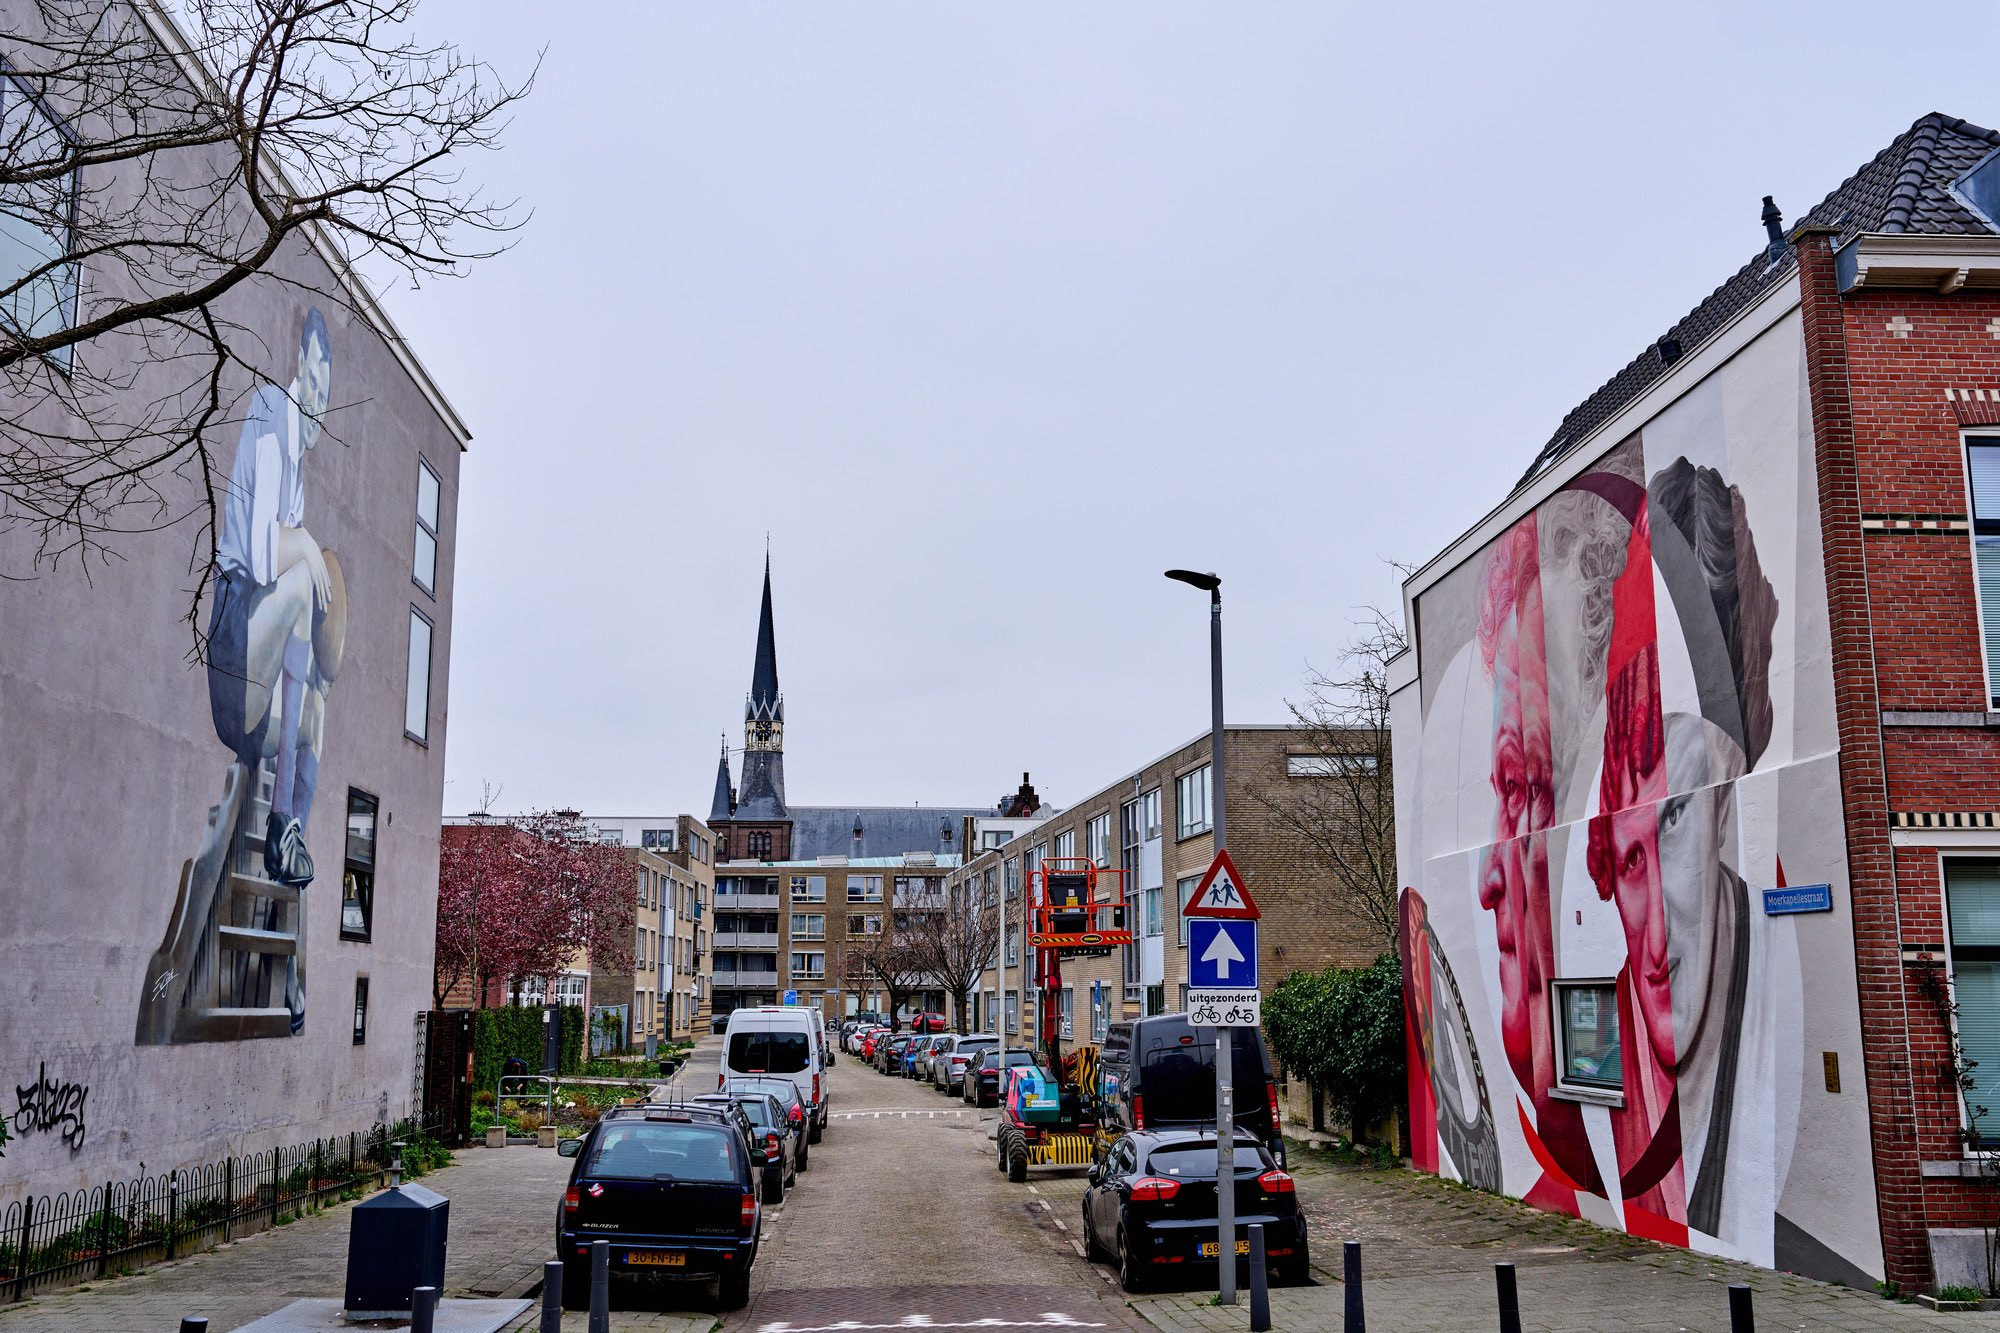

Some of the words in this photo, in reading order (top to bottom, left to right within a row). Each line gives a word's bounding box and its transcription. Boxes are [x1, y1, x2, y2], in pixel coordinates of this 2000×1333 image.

[1767, 893, 1824, 906] Moerkapellestraat
[1189, 993, 1257, 1005] uitgezonderd
[632, 1253, 683, 1264] 30-FN-FF
